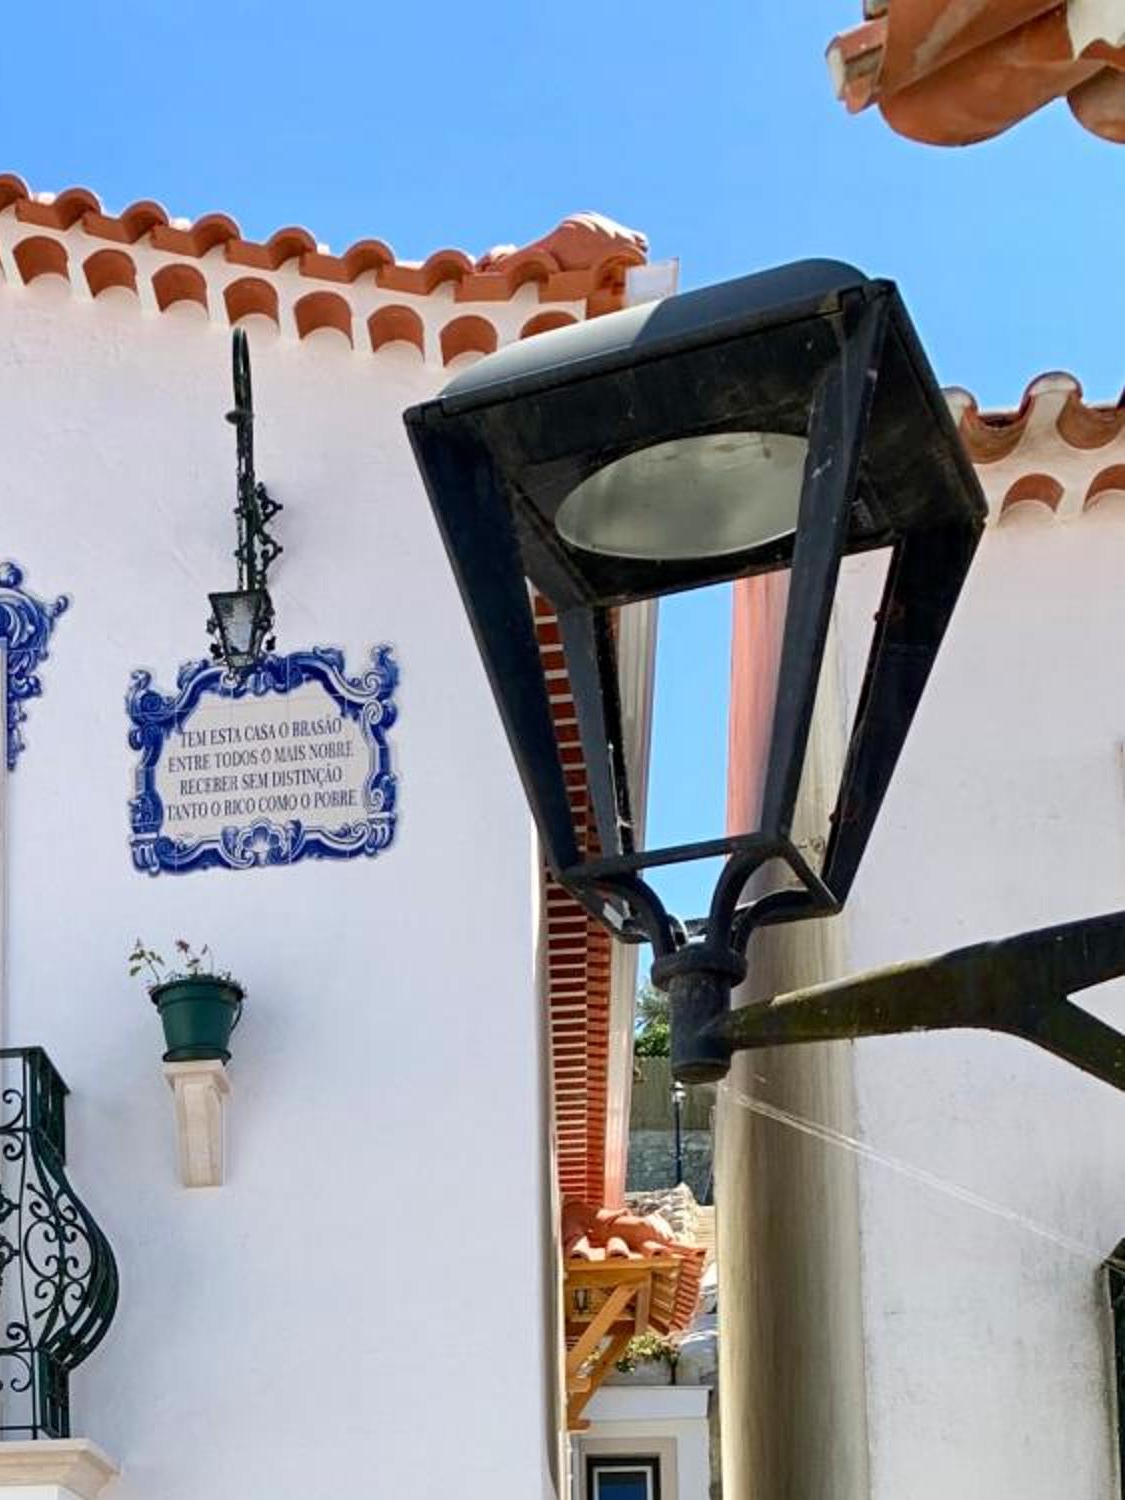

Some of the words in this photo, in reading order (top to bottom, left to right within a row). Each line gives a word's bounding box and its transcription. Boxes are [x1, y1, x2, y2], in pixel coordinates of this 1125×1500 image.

[181, 730, 207, 748] TEM
[210, 727, 242, 745] ESTA
[244, 723, 276, 742] CASA
[279, 721, 290, 738] O
[292, 714, 342, 737] BRASÃO
[168, 754, 211, 774] ENTRE
[214, 749, 258, 769] TODOS
[261, 746, 272, 765] O
[274, 744, 306, 762] MAIS
[309, 740, 354, 760] NOBRE
[180, 775, 238, 796] RECEBER
[242, 771, 268, 790] SEM
[272, 763, 342, 788] DISTINÇÃO
[167, 801, 208, 822] TANTO
[211, 800, 222, 817] O
[224, 797, 256, 816] RICO
[259, 793, 298, 813] COMO
[300, 792, 311, 809] O
